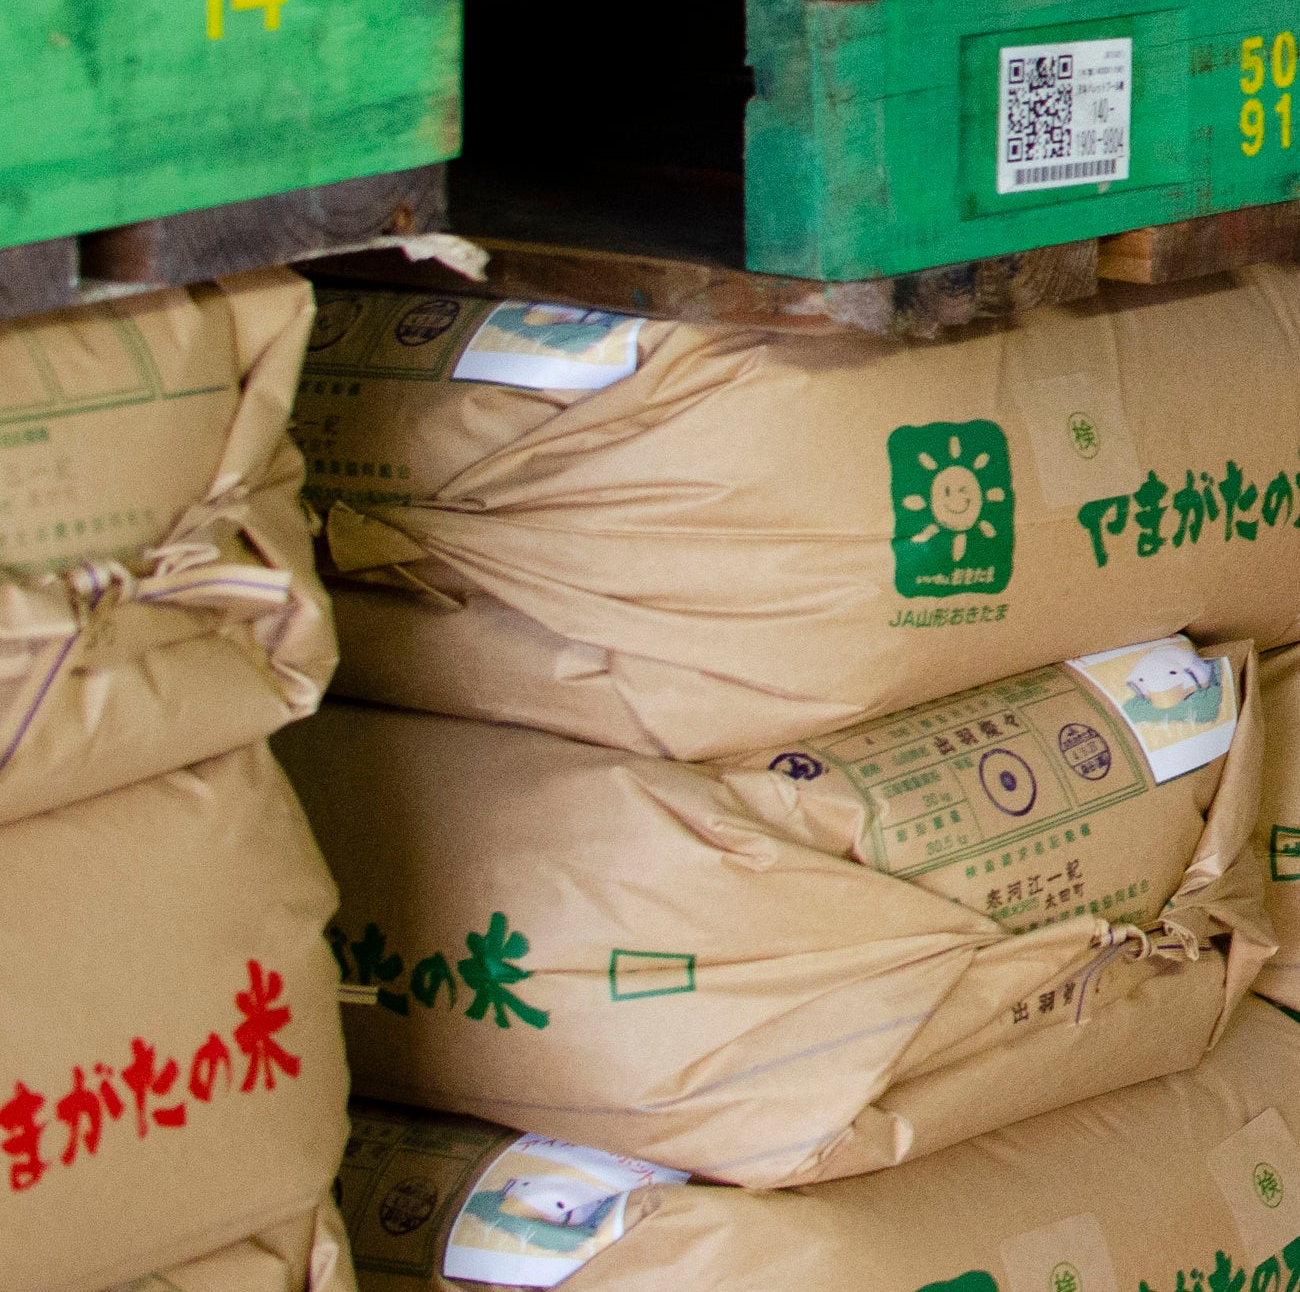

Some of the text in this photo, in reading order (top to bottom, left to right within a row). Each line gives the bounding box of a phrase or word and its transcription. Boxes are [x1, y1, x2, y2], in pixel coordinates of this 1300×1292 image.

[889, 604, 1010, 628] JA山形おきたま
[331, 911, 549, 1029] たの米
